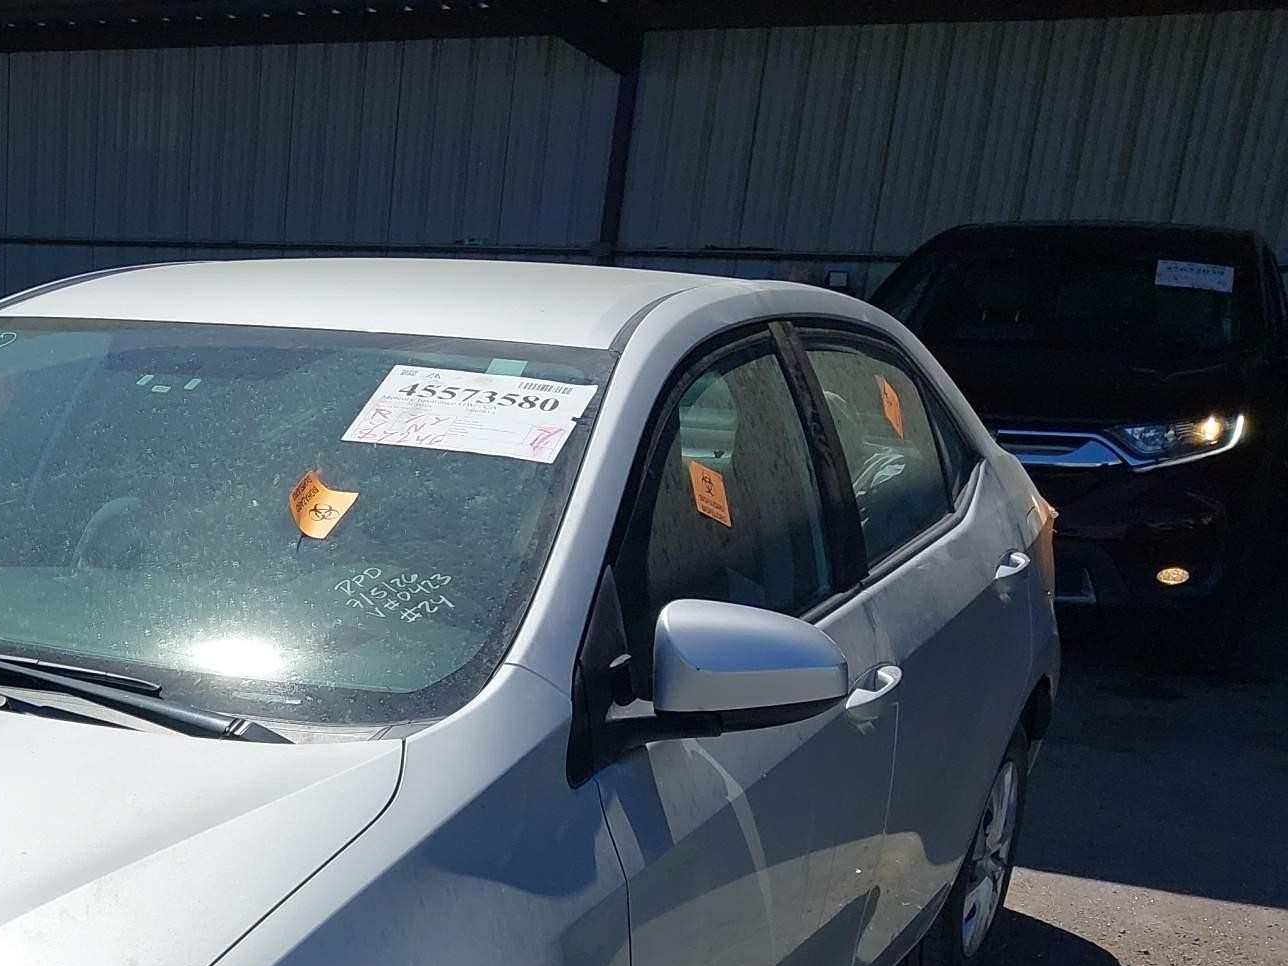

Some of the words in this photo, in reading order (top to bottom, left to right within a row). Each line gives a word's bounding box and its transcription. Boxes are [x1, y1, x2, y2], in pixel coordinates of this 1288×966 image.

[398, 382, 560, 412] 45573580
[334, 567, 382, 595] RPD
[400, 595, 456, 623] #24
